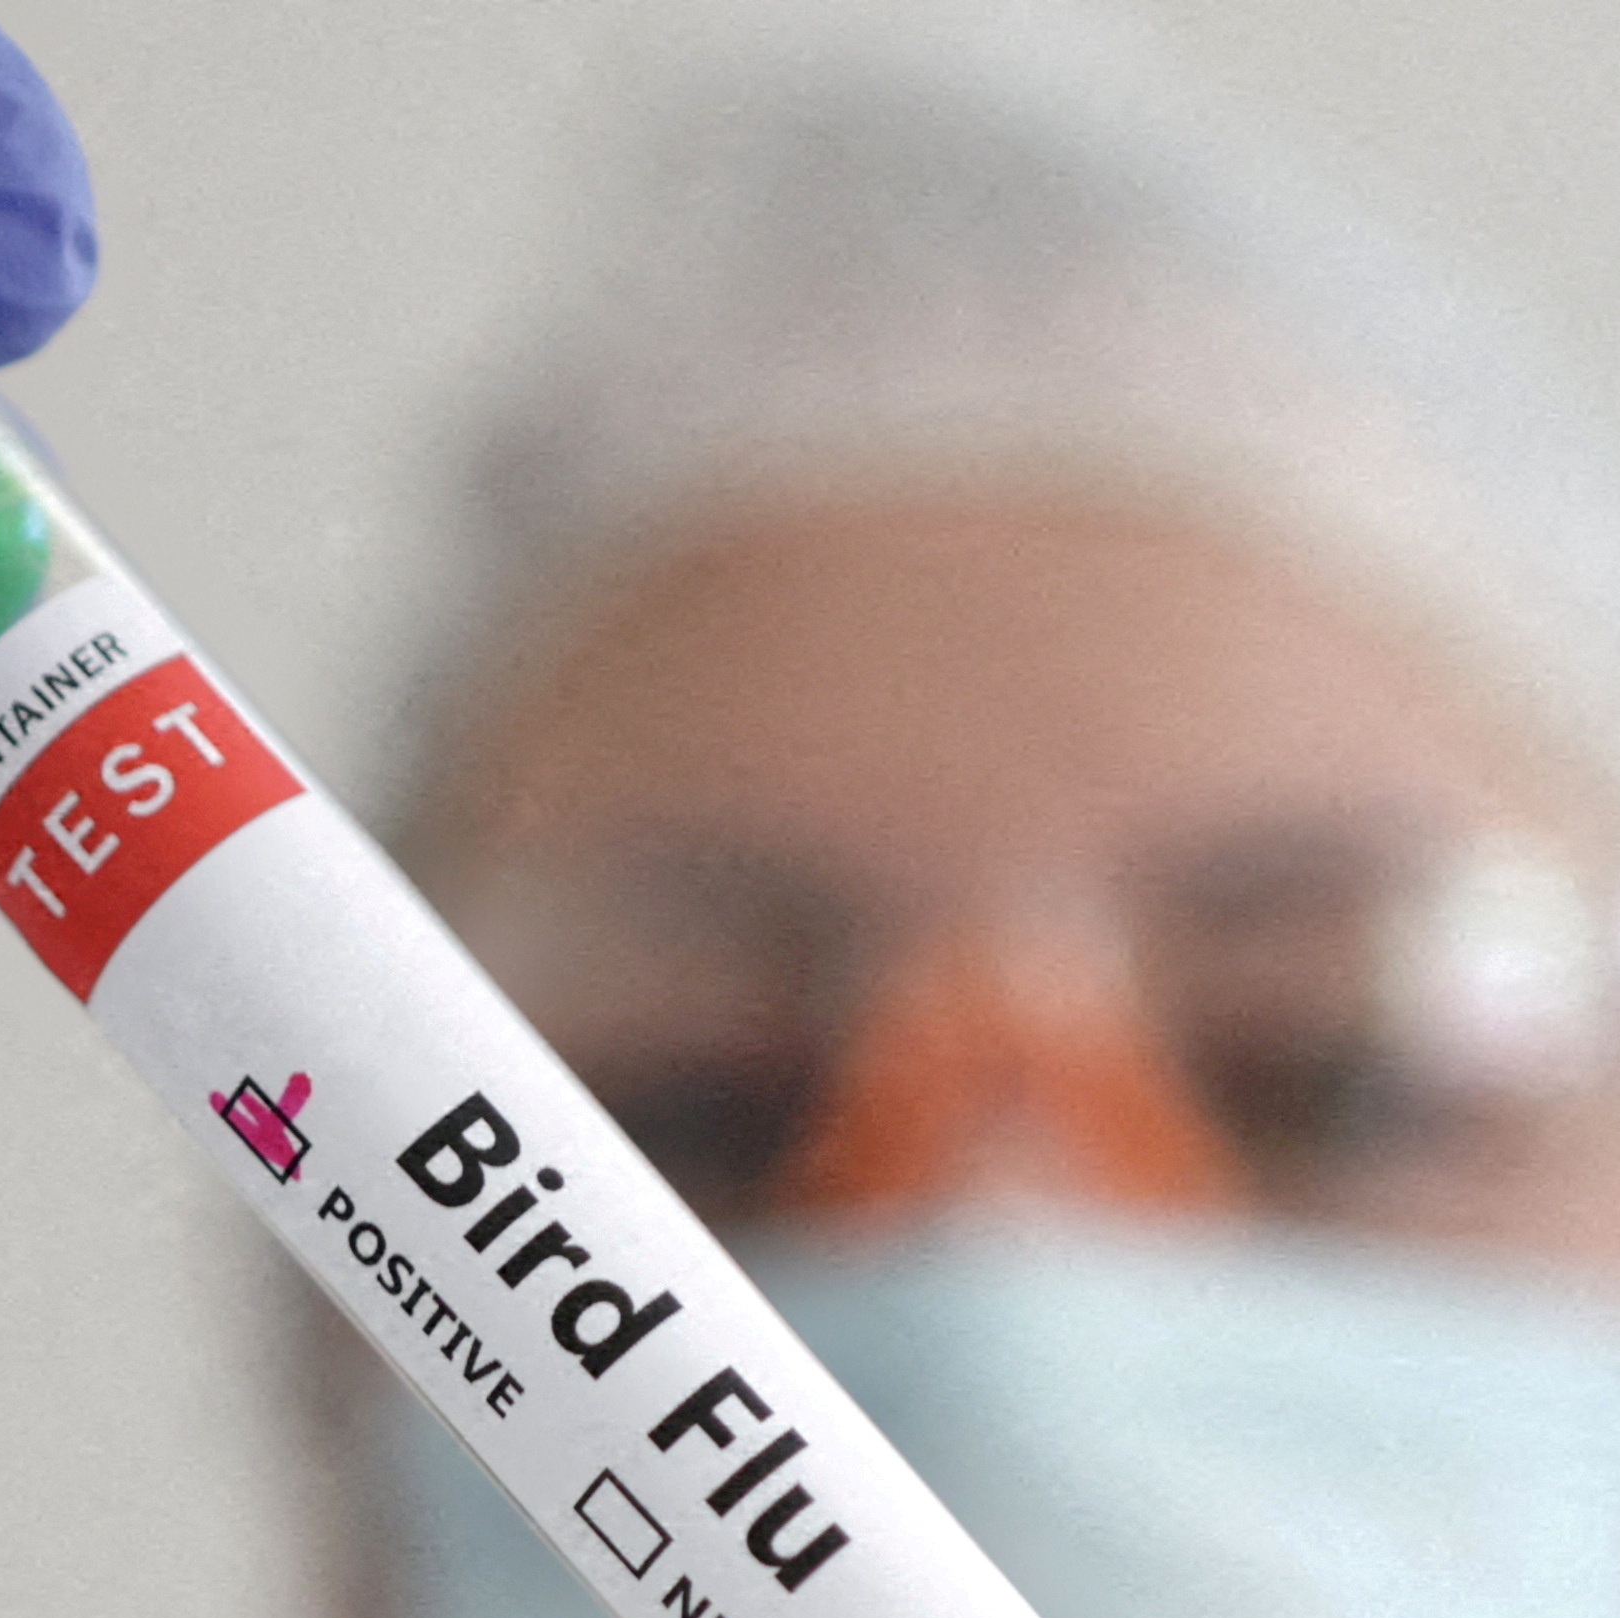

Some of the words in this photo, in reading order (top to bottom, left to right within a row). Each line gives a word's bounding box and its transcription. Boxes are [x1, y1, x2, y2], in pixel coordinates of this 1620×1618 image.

[6, 702, 225, 918] TEST
[317, 1186, 525, 1418] POSITIVE
[396, 1091, 683, 1380] Bird
[647, 1366, 851, 1593] Flu
